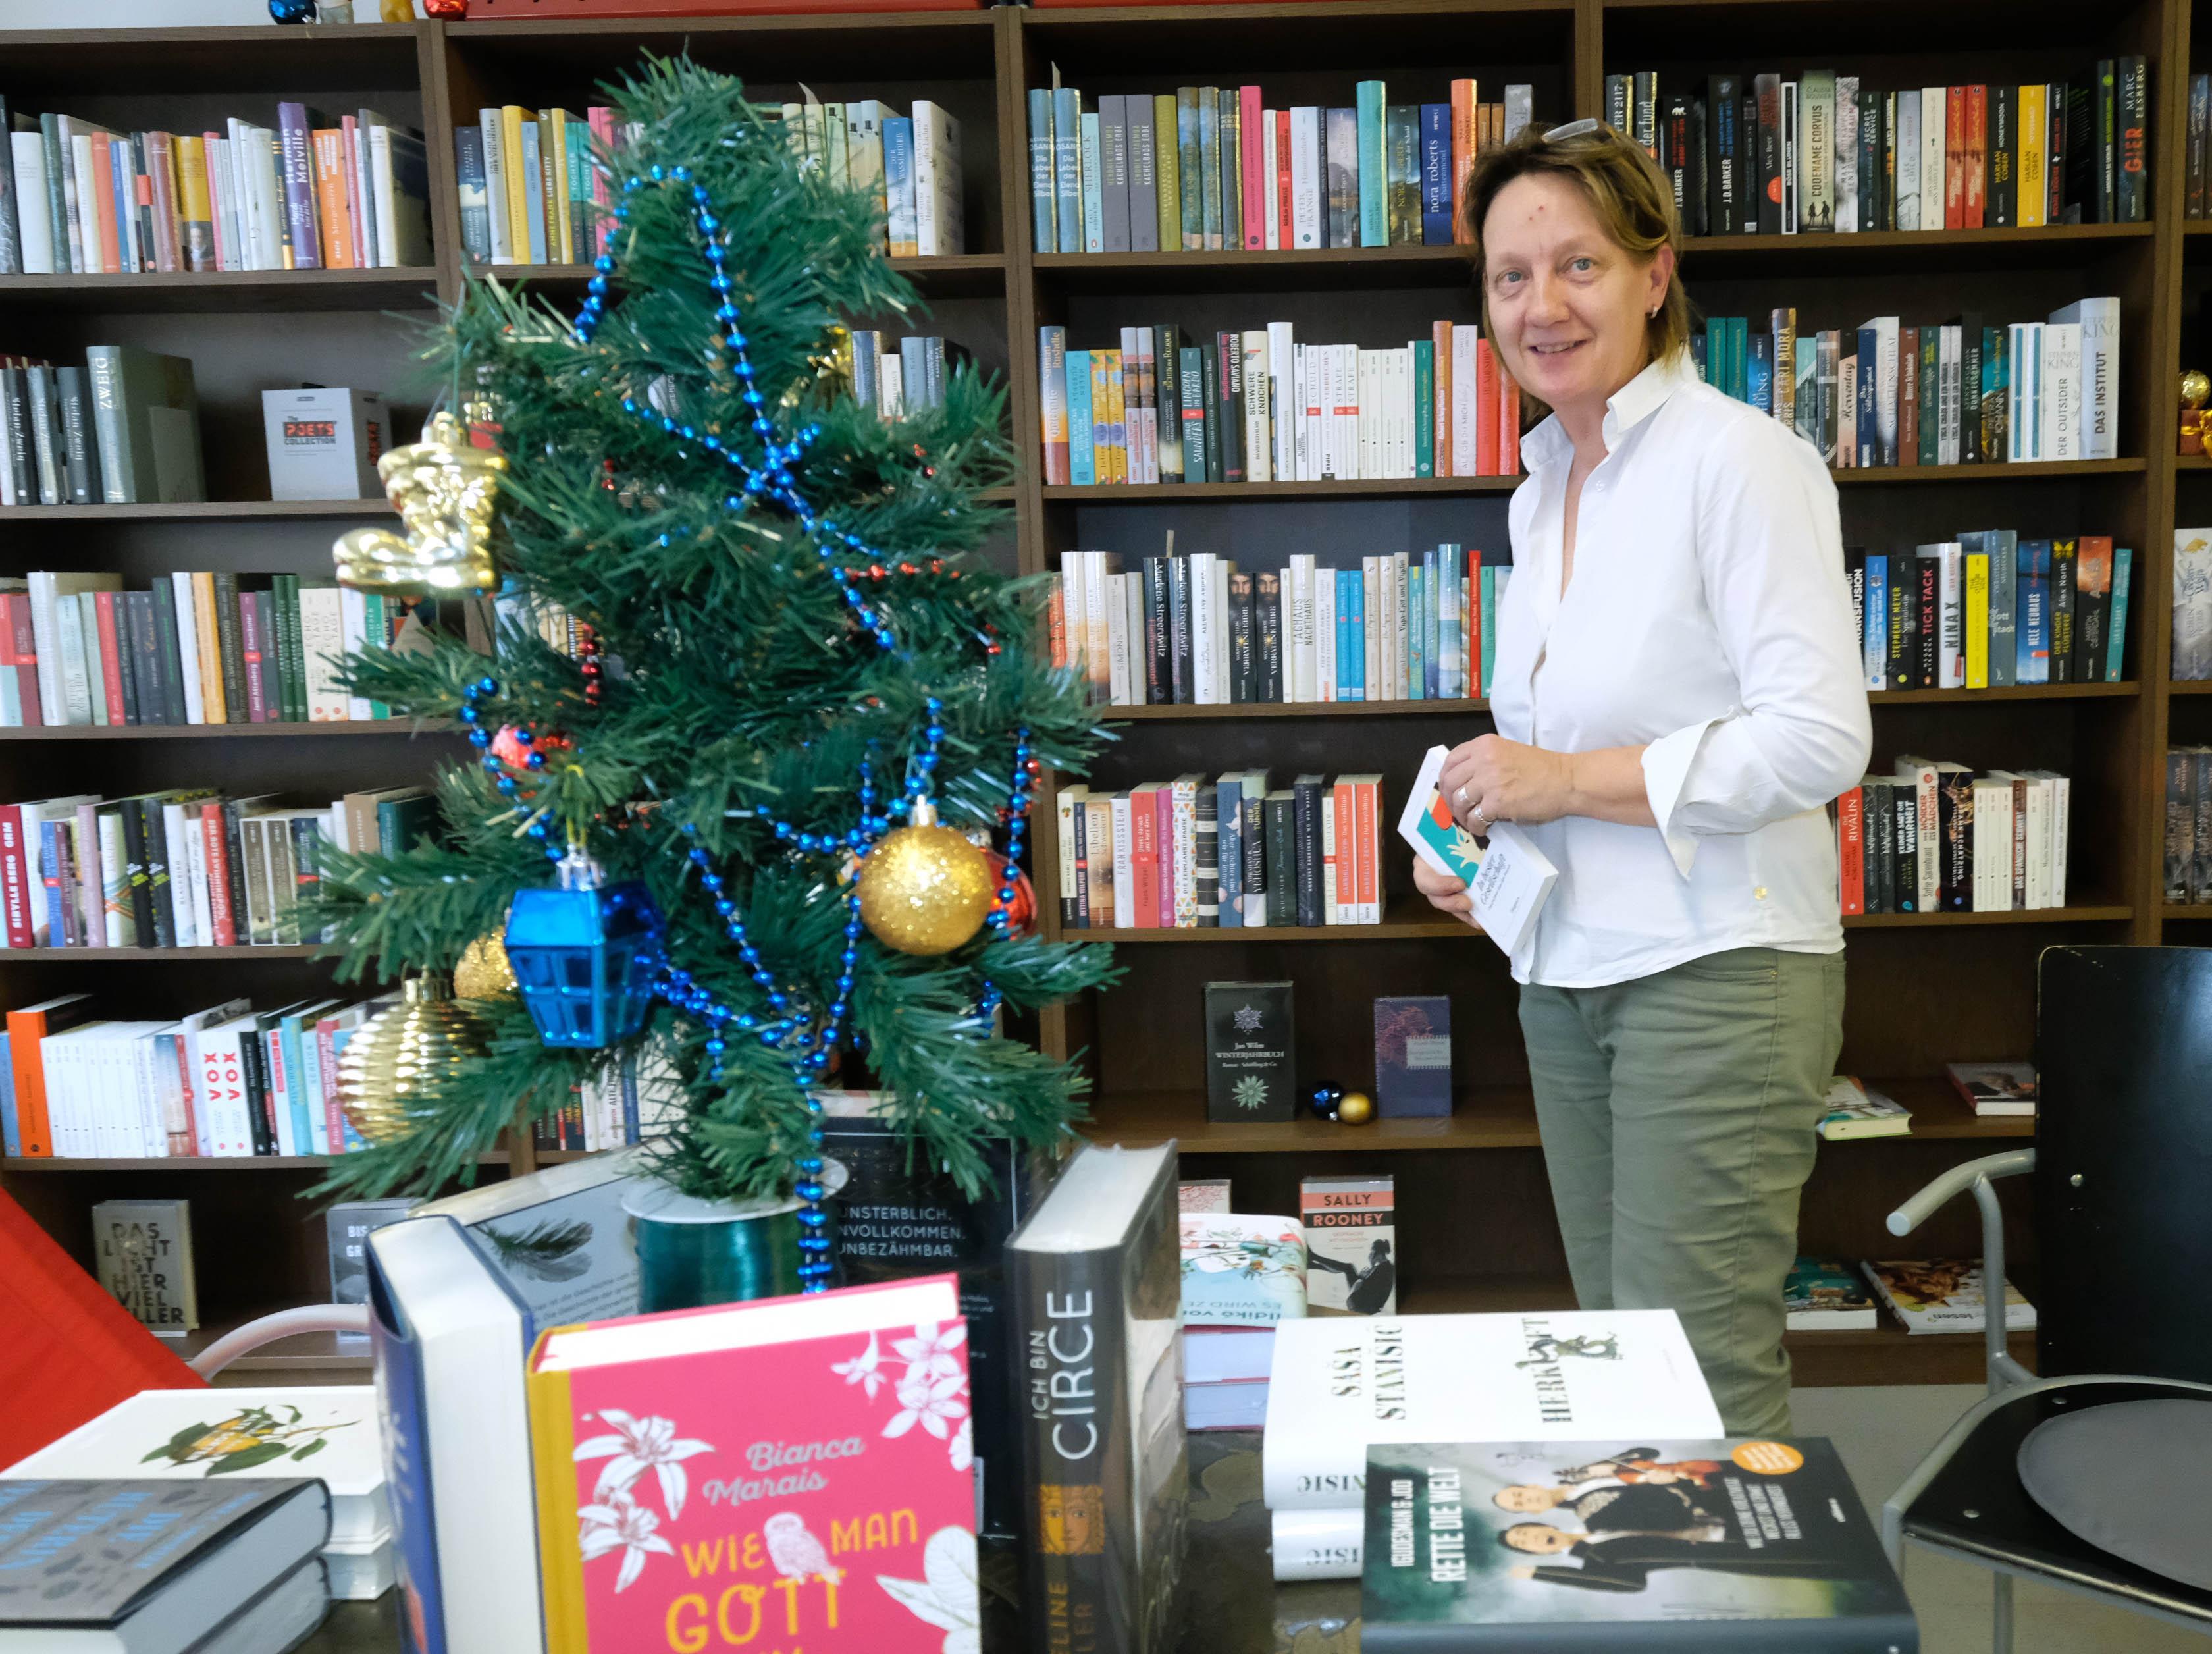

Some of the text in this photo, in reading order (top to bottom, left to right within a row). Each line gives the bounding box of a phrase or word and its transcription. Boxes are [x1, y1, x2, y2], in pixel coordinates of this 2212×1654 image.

[1614, 84, 1623, 107] 2117
[2125, 73, 2134, 111] MARC
[2135, 64, 2144, 119] ELSBERG
[1639, 101, 1652, 146] der fund
[282, 128, 294, 184] Herman
[294, 128, 307, 183] Melville
[1812, 105, 1822, 197] CODENAME CORVUS
[2124, 127, 2142, 173] GIER
[1427, 140, 1439, 213] nora roberts
[1043, 346, 1052, 379] Salman
[1051, 332, 1061, 368] Rushdie
[1778, 327, 1791, 394] CARI MORA
[95, 358, 113, 409] ZWEIG
[1182, 371, 1193, 407] LINCOLN
[1231, 365, 1240, 392] SAVIANO
[2094, 352, 2106, 434] DAS INSTITUT
[2058, 378, 2068, 456] DER OUTSIDER
[1193, 421, 1203, 463] SAUNDERS
[1155, 564, 1164, 602] Marlene
[1922, 569, 1934, 635] TICK TACK
[2058, 563, 2068, 608] Alex North
[1293, 599, 1304, 645] TAGHAUS
[1304, 599, 1313, 645] NACHTHAUS
[1892, 587, 1902, 658] STEPHENIE MEYER
[1944, 602, 1960, 649] NINA X
[2027, 593, 2040, 645] NELE NEUHAUS
[2062, 613, 2071, 653] FLÜSTERER
[1090, 813, 1099, 855] Libellen
[1116, 808, 1126, 875] FRANKISSSTEIN
[1847, 799, 1858, 841] RIVALIN
[1904, 800, 1916, 853] WAHRHEIT
[3, 822, 22, 928] SIBYLLE BERG GRM
[1253, 840, 1262, 892] YEHOSHUA
[1923, 847, 1934, 897] Sofie Sarenbrant
[204, 1052, 222, 1101] VOX
[224, 1052, 240, 1101] VOX
[1313, 1213, 1384, 1227] ROONEY
[1324, 1194, 1371, 1206] SALLY
[104, 1240, 171, 1256] LHT
[111, 1223, 159, 1239] DAS
[839, 1226, 966, 1240] NVOLLKOMMEN.
[117, 1291, 167, 1306] VIEL
[132, 1307, 184, 1323] LLER
[1224, 1310, 1281, 1321] Ildikó
[1028, 1330, 1049, 1420] ICH BIN
[1046, 1289, 1098, 1460] CIRCE
[745, 1435, 866, 1473] Bianca
[702, 1467, 828, 1507] Marais
[681, 1508, 918, 1579] WIE MAN
[1390, 1480, 1415, 1567] IGUDESMAN JOO
[1427, 1467, 1467, 1582] RETTE DIE WELT
[665, 1568, 847, 1654] GOTT
